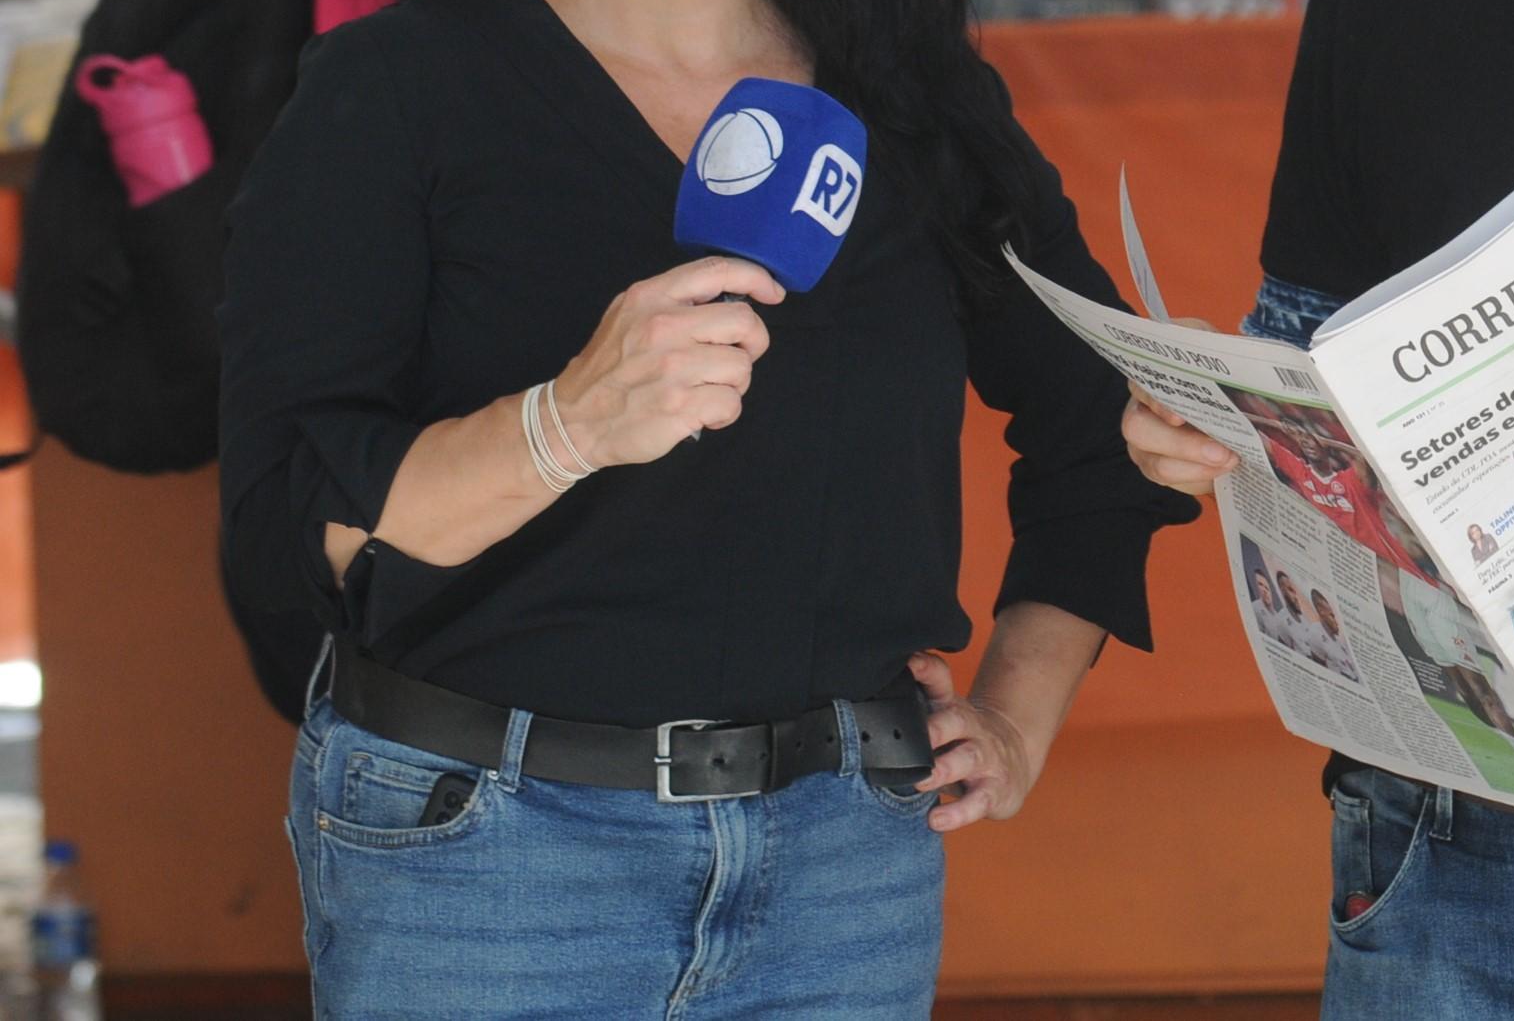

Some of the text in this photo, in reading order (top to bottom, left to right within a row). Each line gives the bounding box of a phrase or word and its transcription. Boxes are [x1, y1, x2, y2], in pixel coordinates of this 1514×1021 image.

[810, 154, 858, 219] R7
[1397, 403, 1495, 473] Setores
[1412, 423, 1501, 490] vendas
